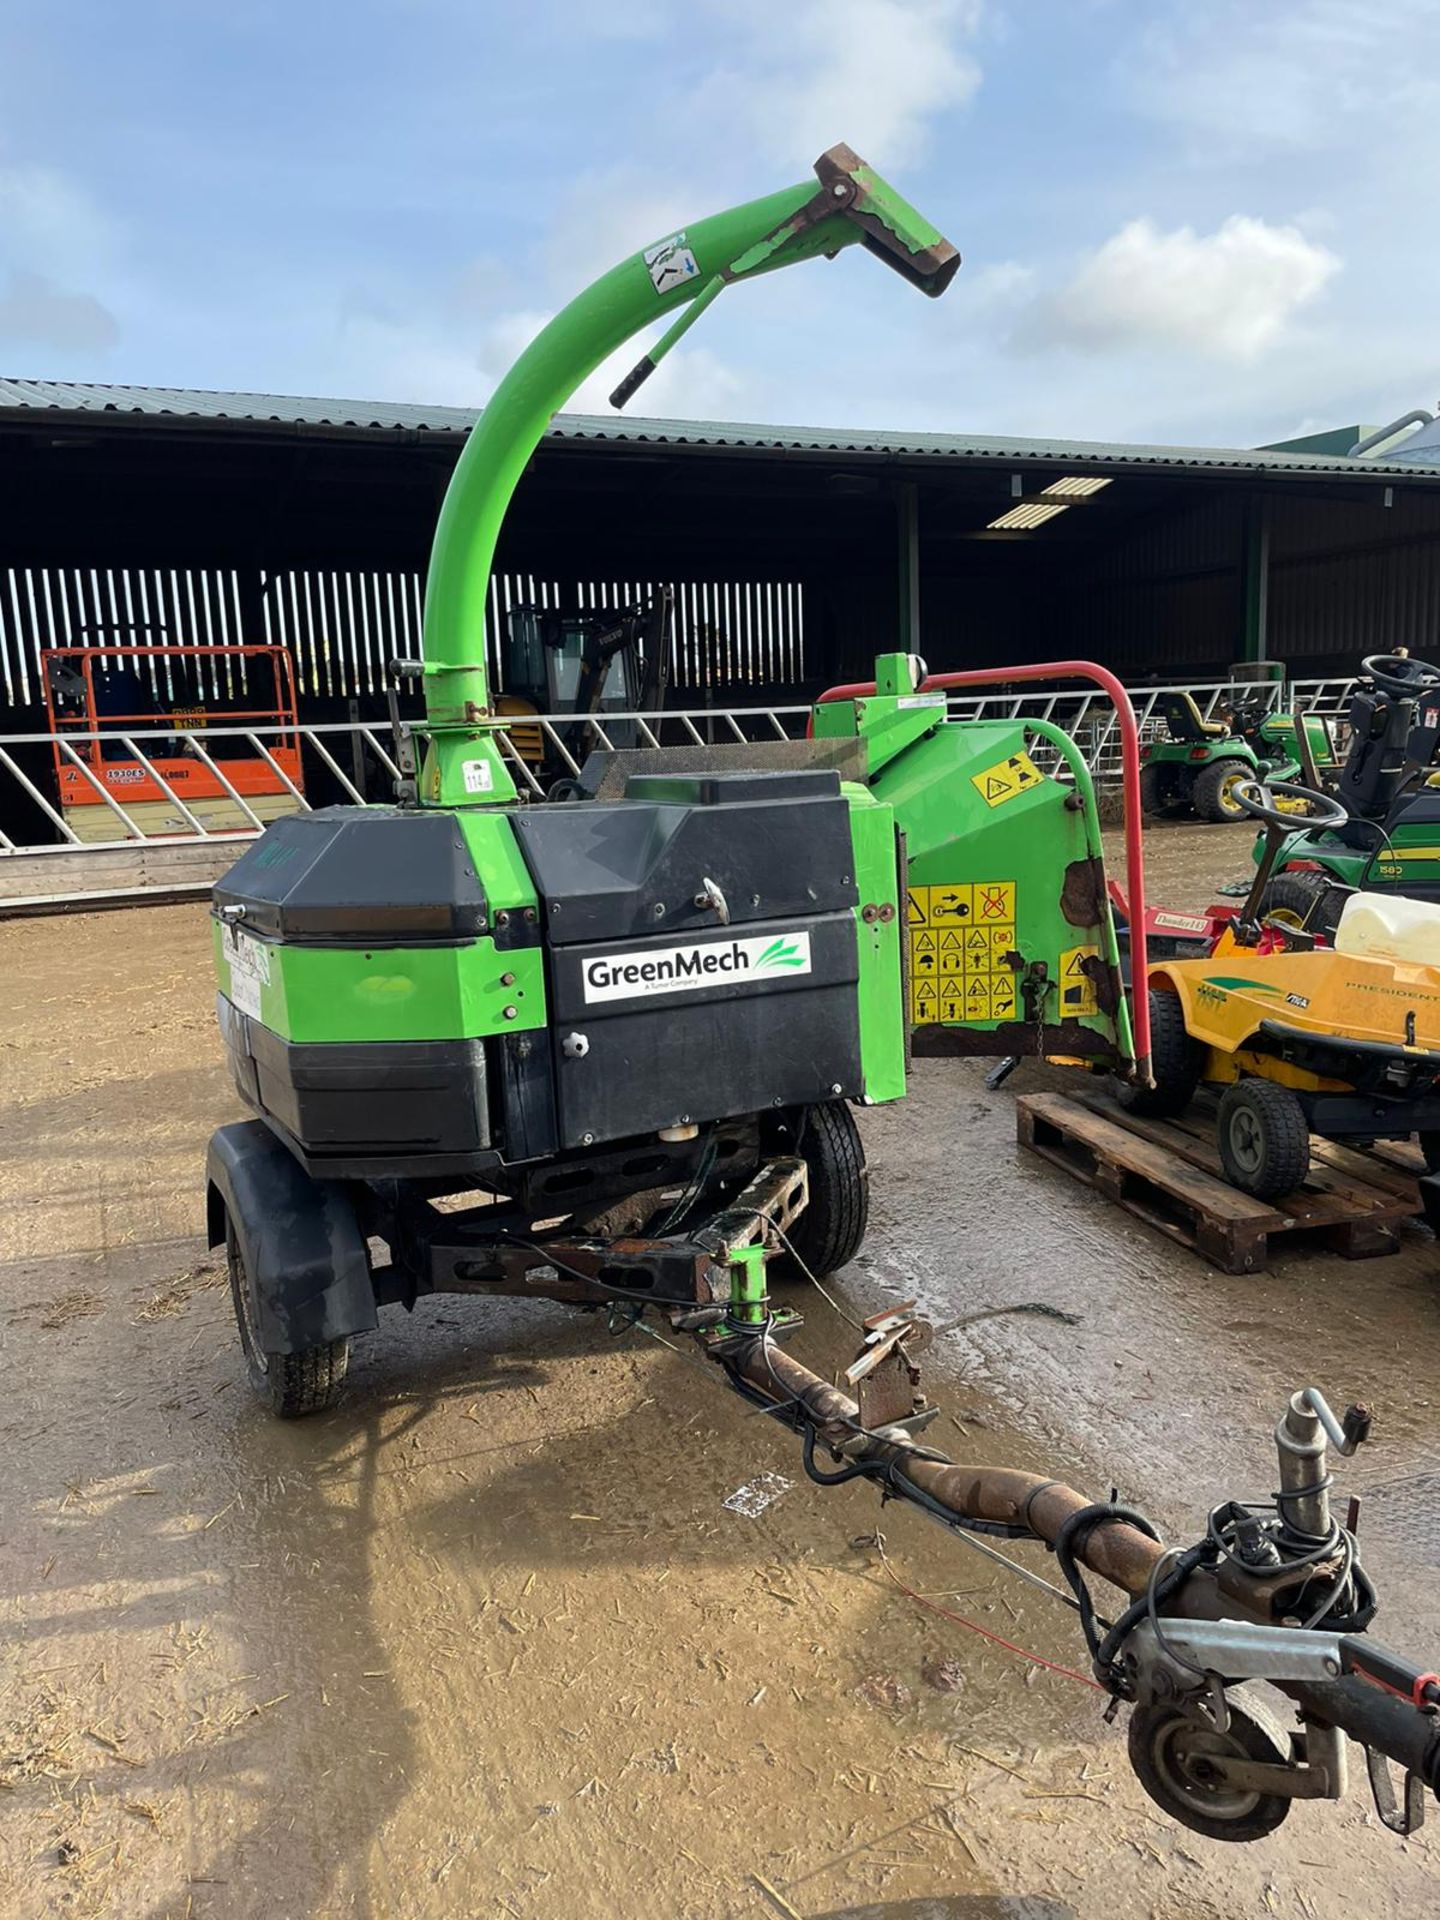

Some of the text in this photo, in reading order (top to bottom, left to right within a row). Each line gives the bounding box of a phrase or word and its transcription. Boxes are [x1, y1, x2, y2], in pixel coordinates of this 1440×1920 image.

[108, 769, 145, 779] 1930ES
[588, 943, 748, 988] GreenMech
[670, 979, 698, 987] Company
[1345, 982, 1440, 1002] PRESIDENT
